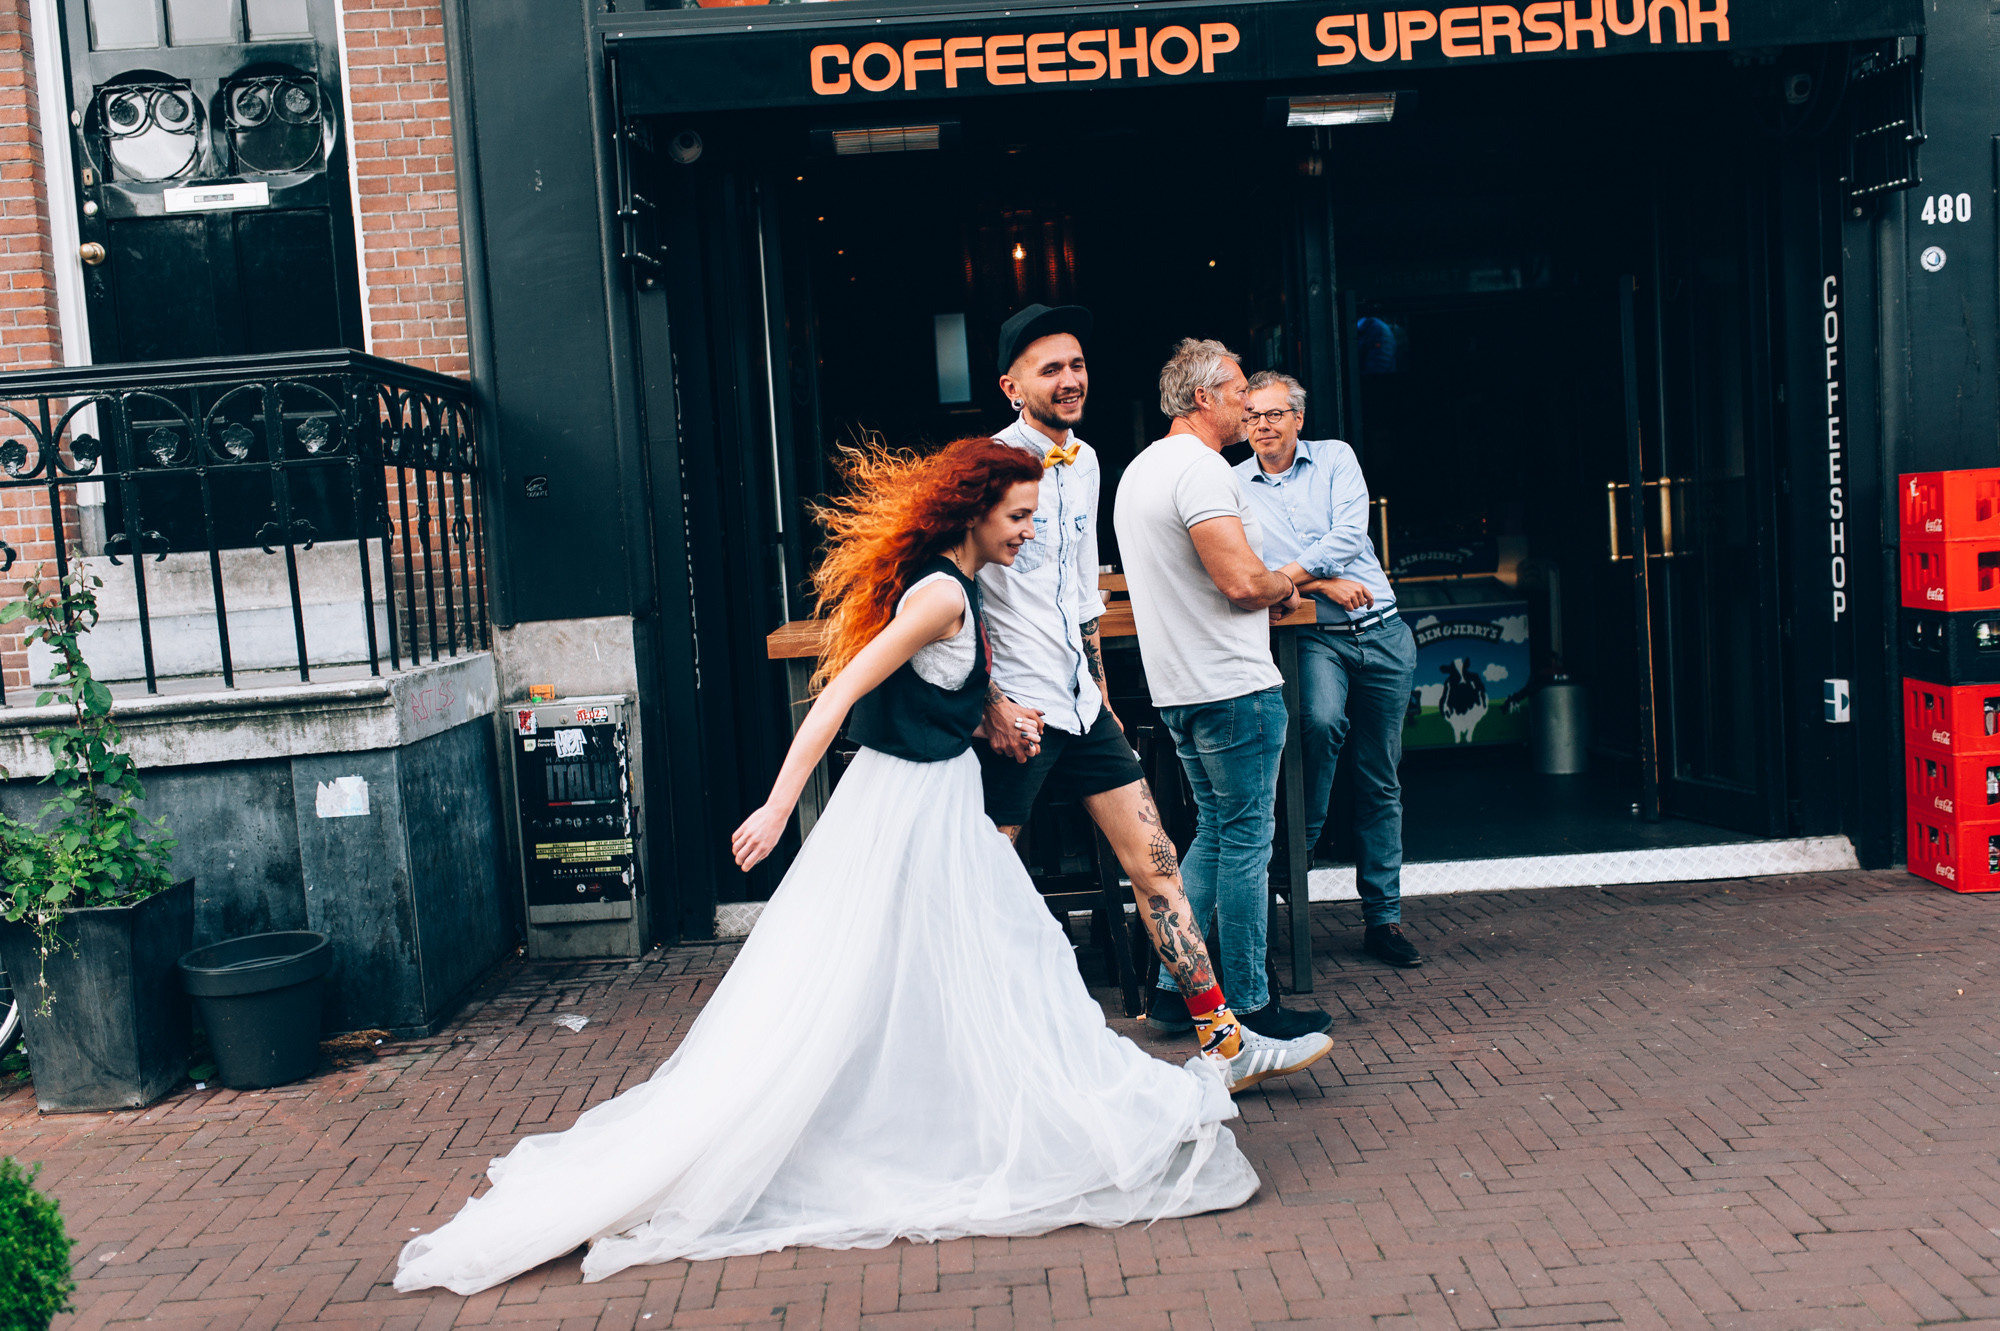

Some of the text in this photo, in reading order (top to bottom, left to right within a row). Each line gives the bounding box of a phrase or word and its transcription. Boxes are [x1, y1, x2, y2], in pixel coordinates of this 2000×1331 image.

[811, 0, 1729, 95] COFFEESHOP SUPERSKUNK
[1921, 193, 1971, 224] 480
[1822, 275, 1846, 622] COFFEESHOP
[1417, 628, 1441, 645] BEN
[1453, 624, 1498, 639] JERRY'S
[546, 762, 618, 801] ITALIA
